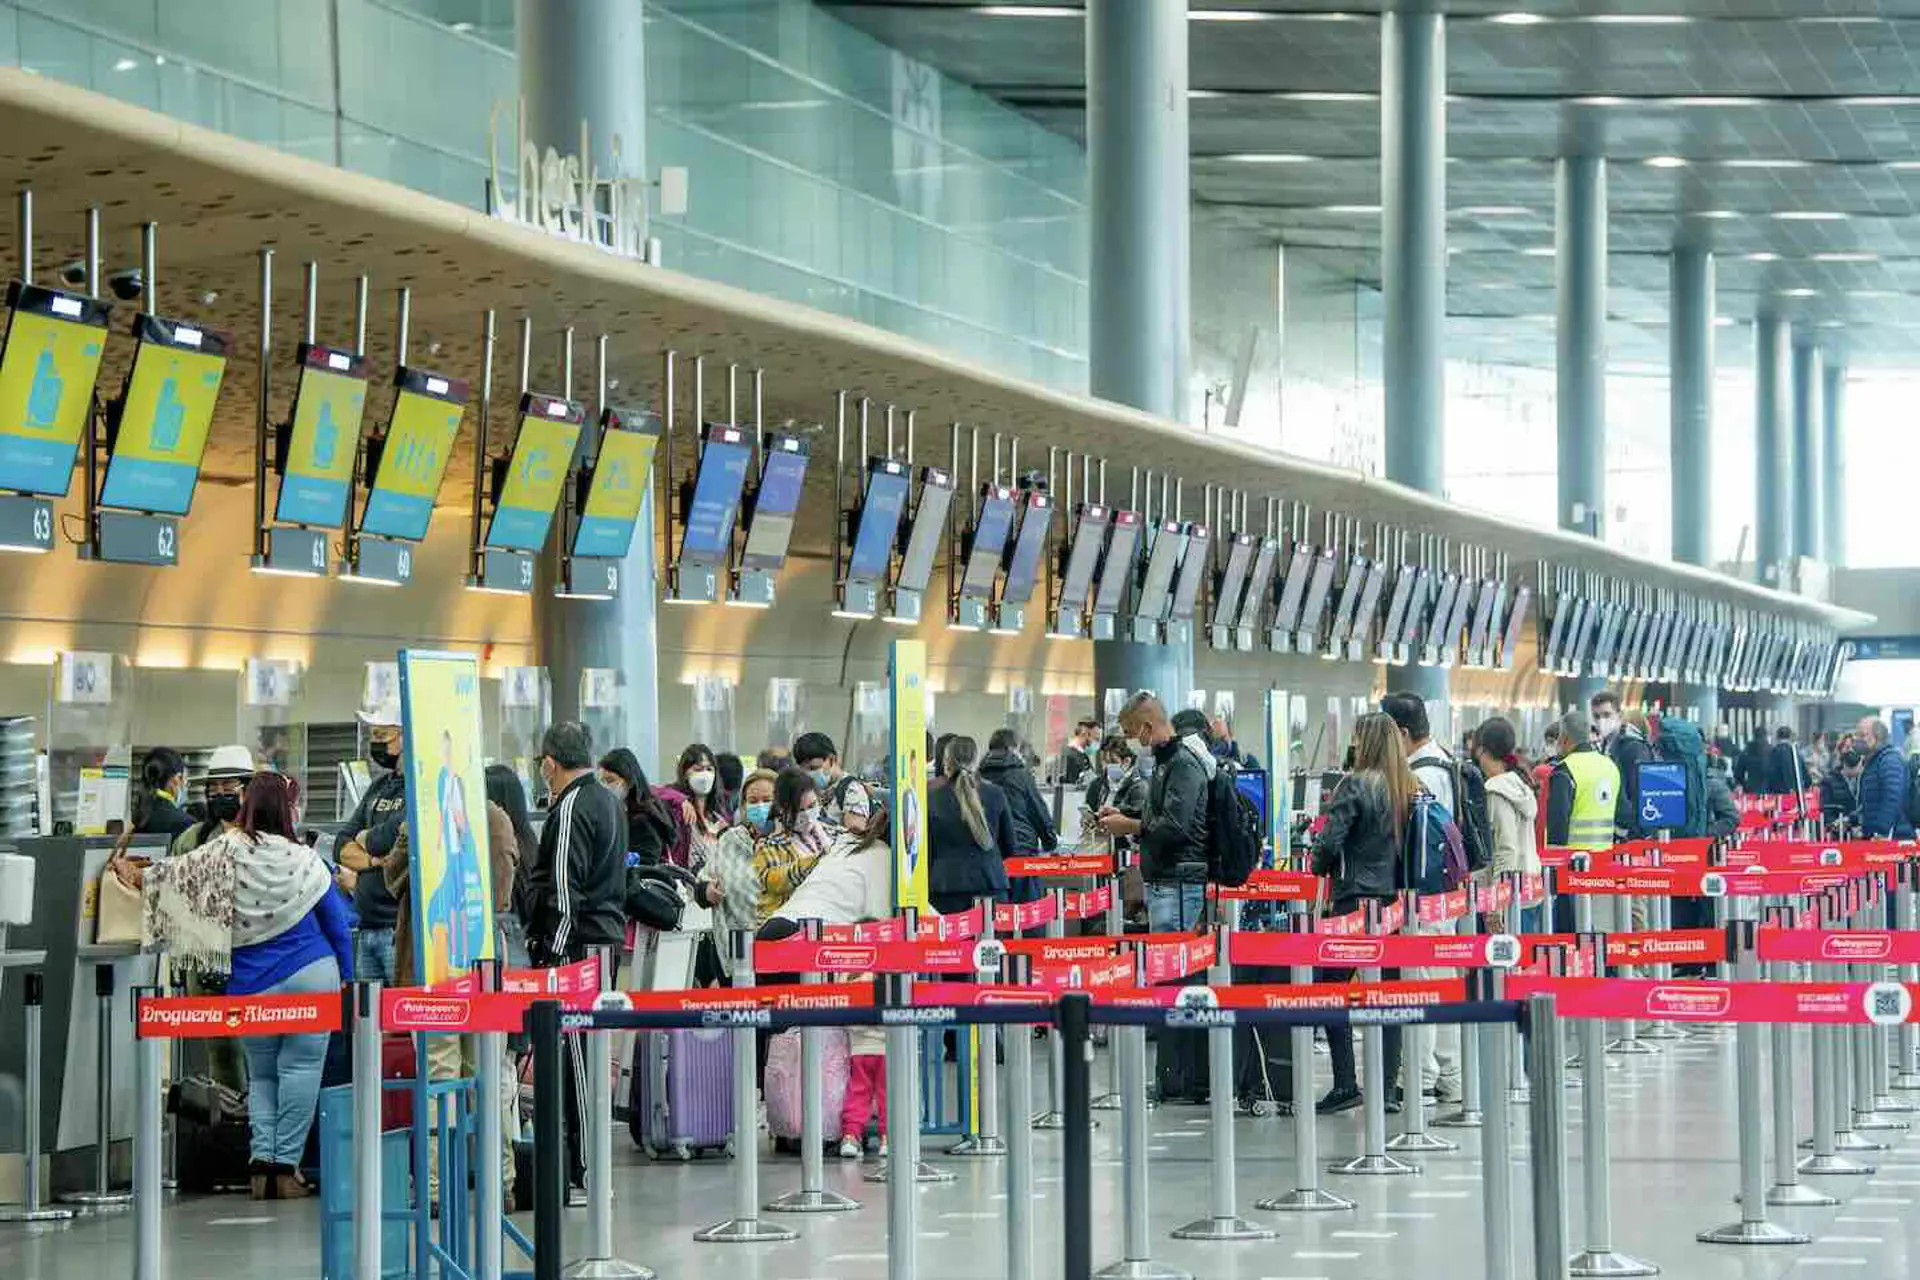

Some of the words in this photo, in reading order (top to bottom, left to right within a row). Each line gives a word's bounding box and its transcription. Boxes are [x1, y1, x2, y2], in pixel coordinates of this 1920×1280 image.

[490, 92, 599, 247] Check
[33, 508, 50, 540] 63
[158, 524, 174, 556] 62
[312, 540, 325, 567] 61
[397, 549, 409, 578] 60
[244, 1004, 318, 1023] Alemana
